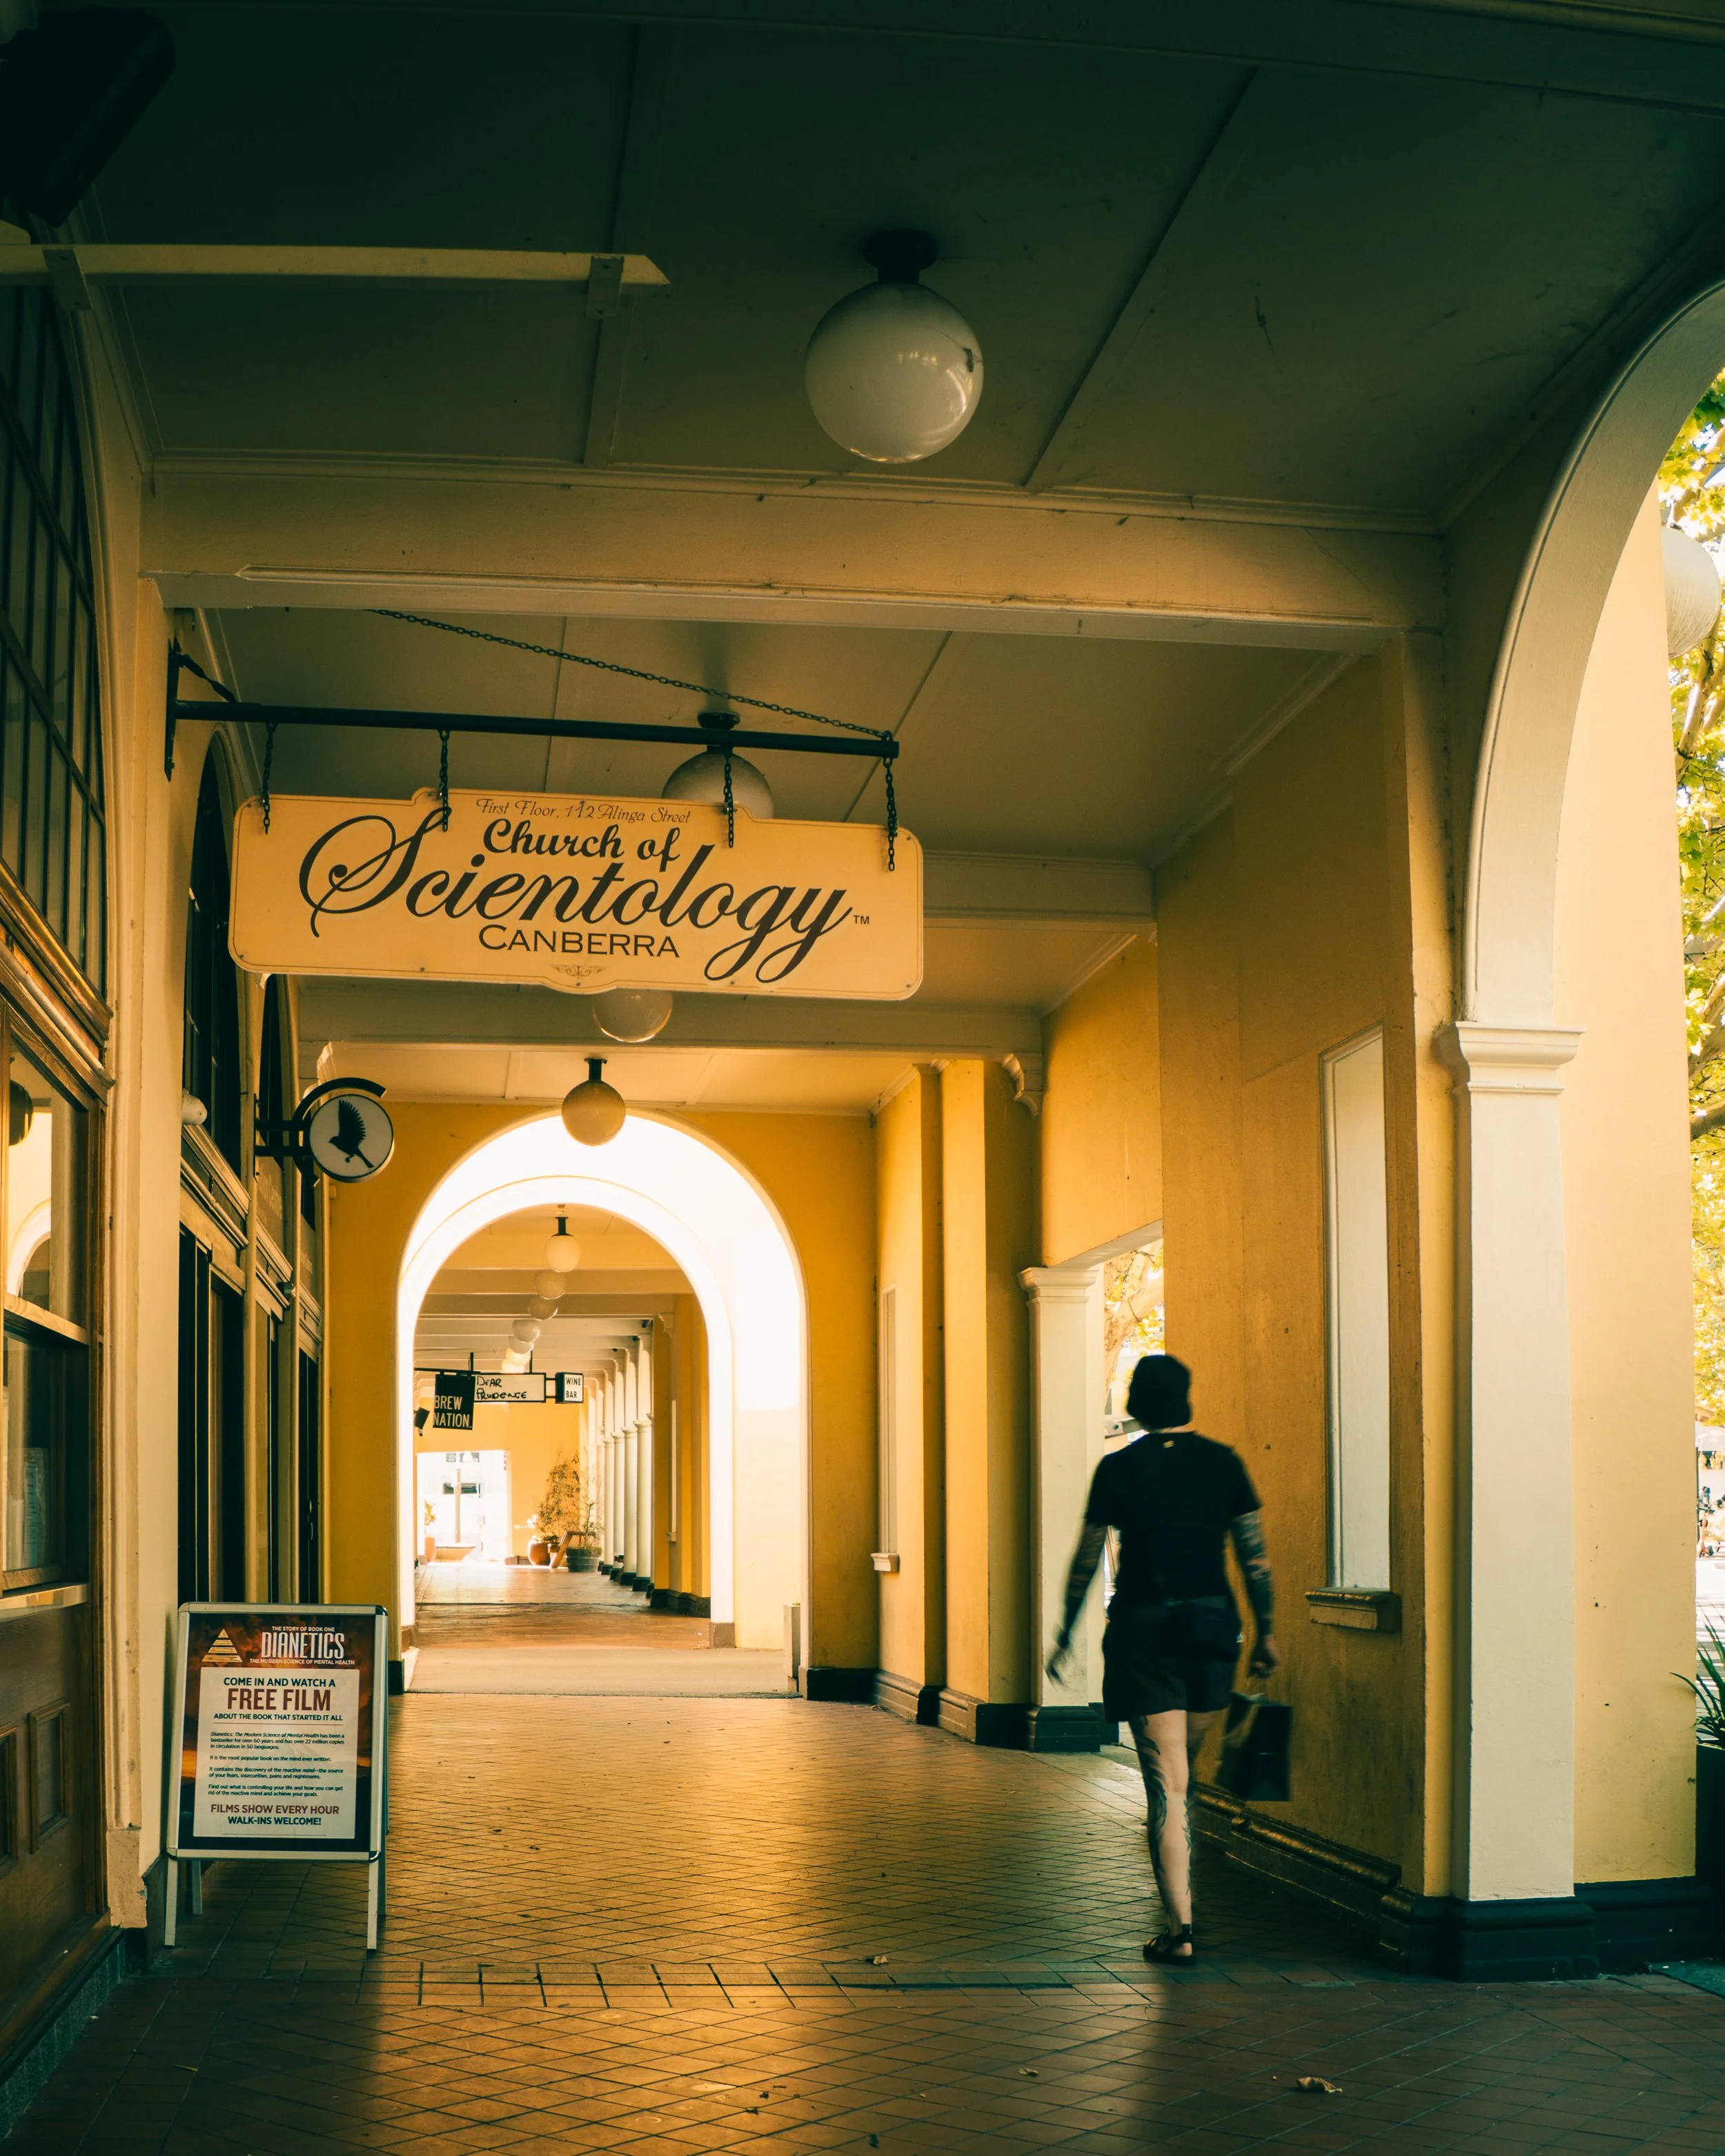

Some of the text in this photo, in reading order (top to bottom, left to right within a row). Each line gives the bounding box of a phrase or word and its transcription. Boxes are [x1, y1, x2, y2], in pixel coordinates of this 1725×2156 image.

[476, 798, 691, 823] First Floor, 112 Alinga Street
[484, 818, 680, 872] Church of
[299, 807, 853, 983] Scientology
[479, 924, 680, 958] CANBERRA
[566, 1377, 581, 1385] WINE
[566, 1390, 578, 1398] BAR
[434, 1395, 462, 1410] BREW
[433, 1412, 472, 1428] NATION.
[262, 1632, 345, 1659] DIANETICS
[291, 1679, 326, 1687] WATCH
[228, 1688, 331, 1710] FREE FILM
[210, 1804, 339, 1814] FILMS SHOW EVERY HOUR
[228, 1816, 272, 1824] WALK-INS
